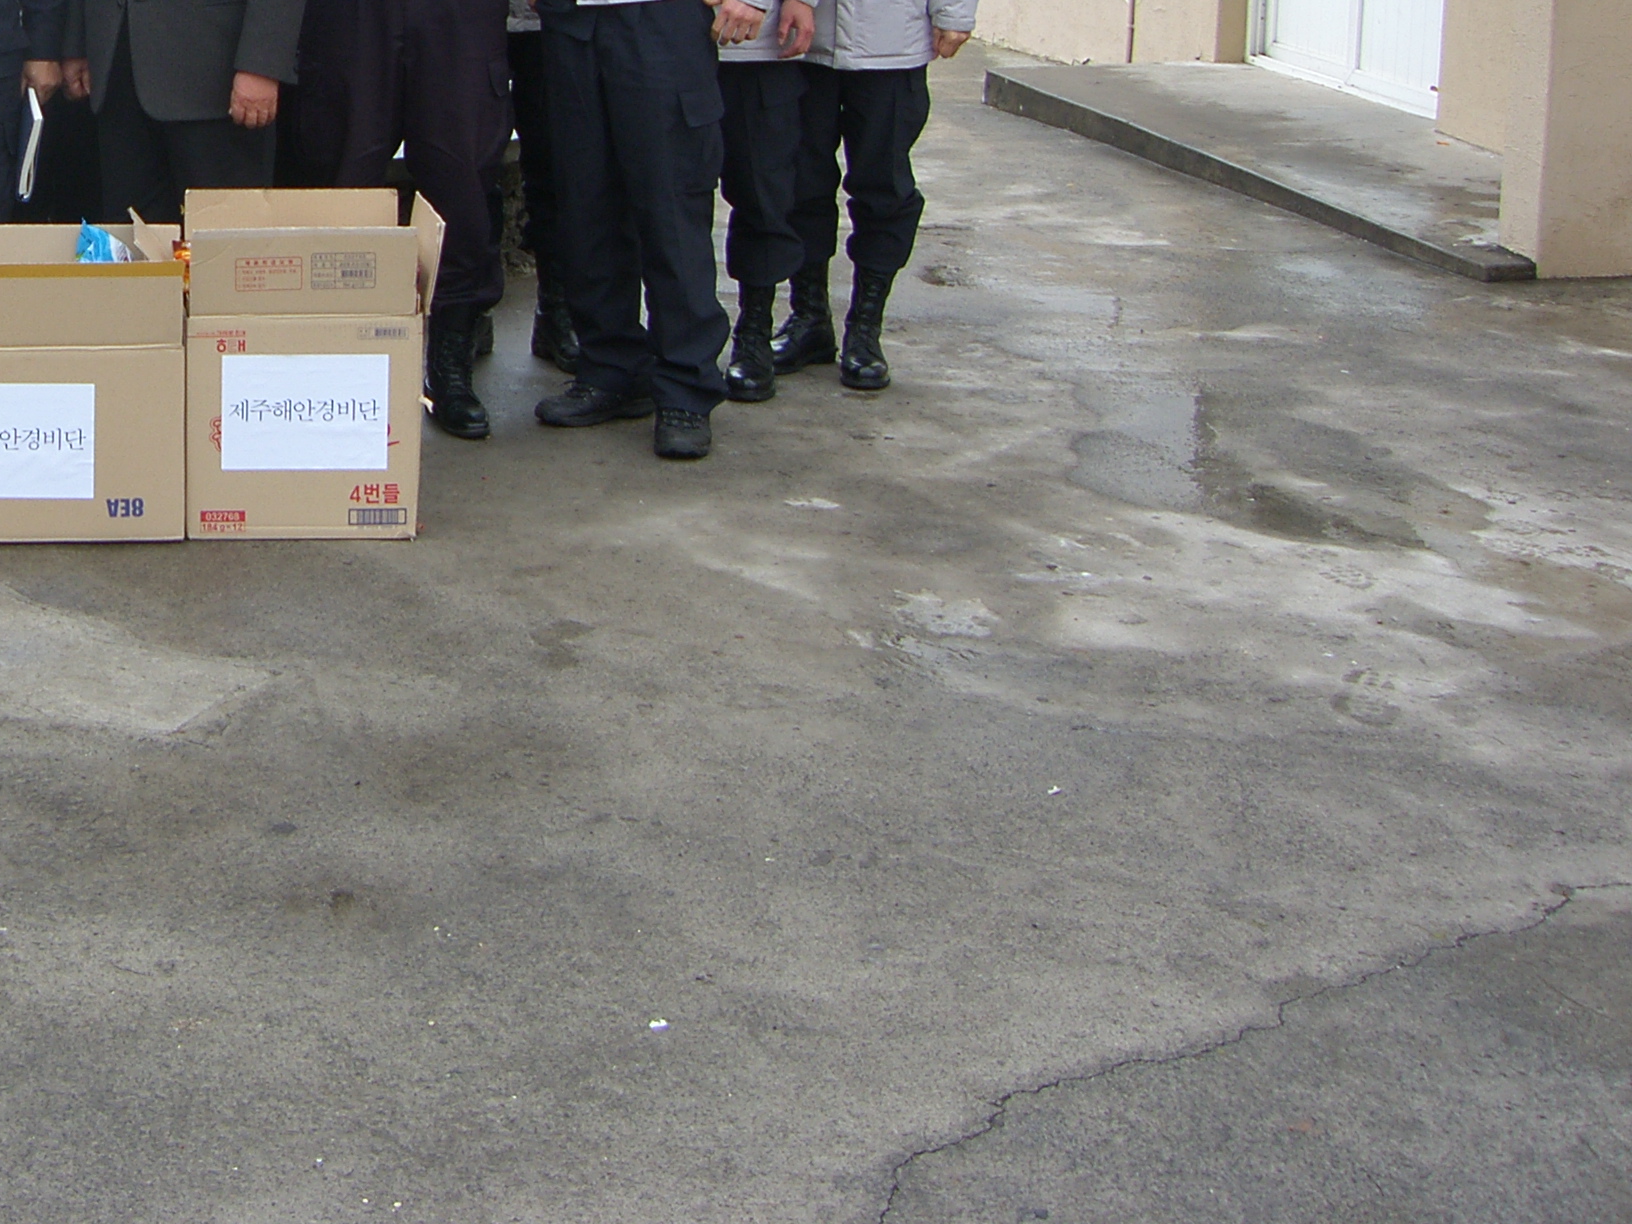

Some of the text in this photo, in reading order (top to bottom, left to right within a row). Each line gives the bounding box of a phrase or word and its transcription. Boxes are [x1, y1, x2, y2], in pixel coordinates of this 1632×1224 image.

[229, 398, 380, 423] 제주해안경비단
[349, 483, 400, 504] 4번들
[106, 497, 144, 518] 8EA
